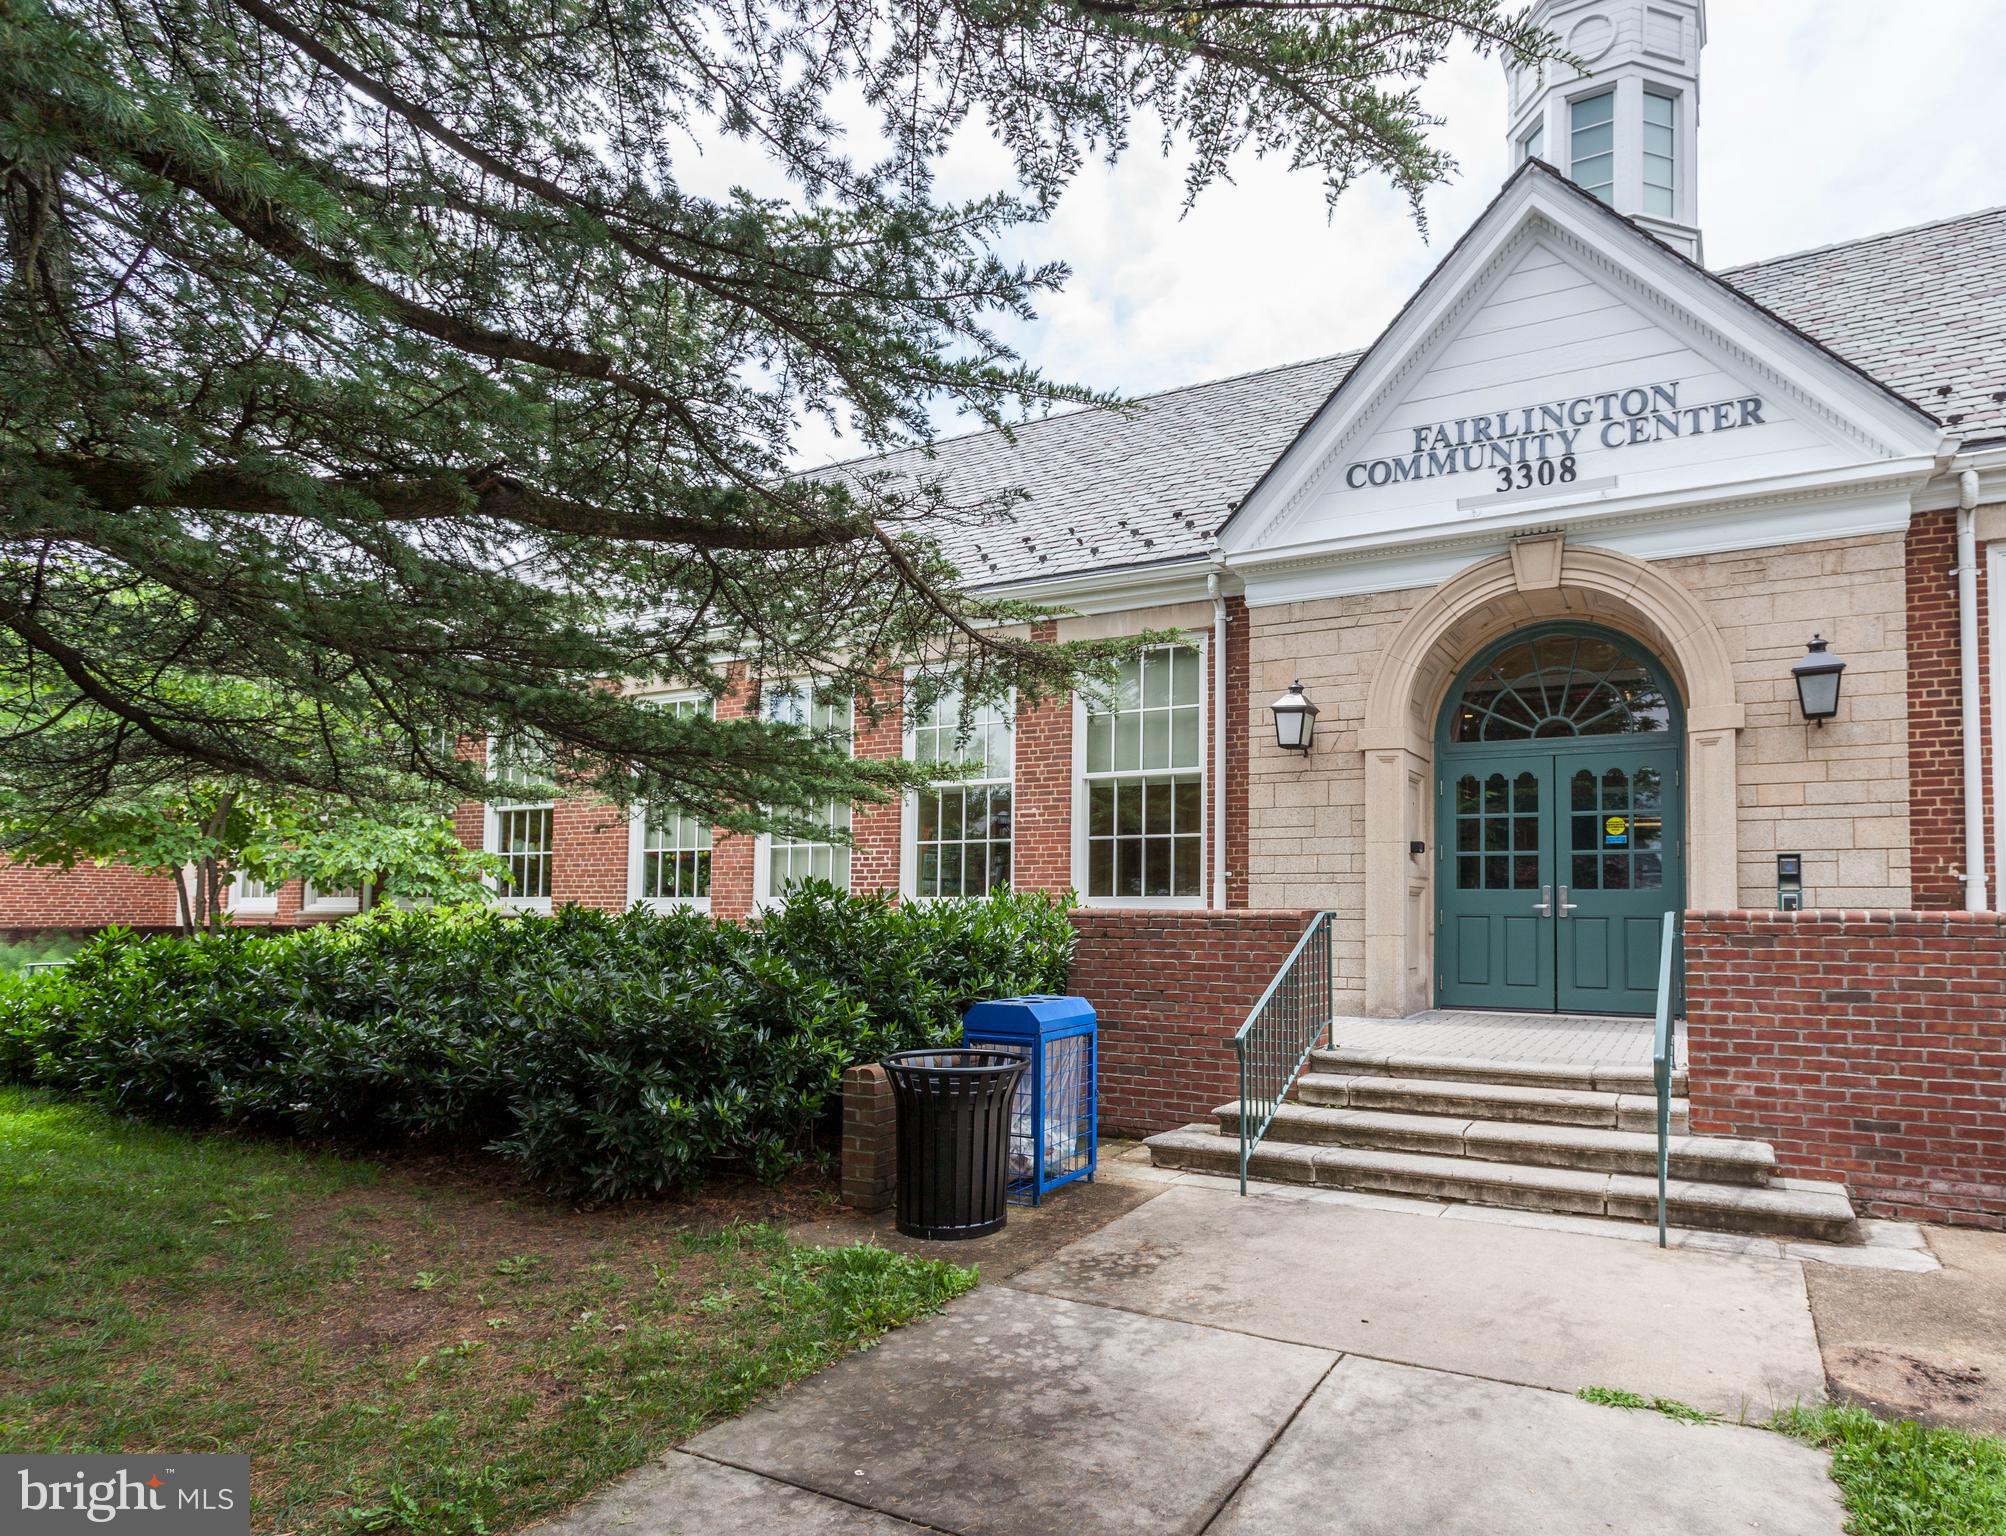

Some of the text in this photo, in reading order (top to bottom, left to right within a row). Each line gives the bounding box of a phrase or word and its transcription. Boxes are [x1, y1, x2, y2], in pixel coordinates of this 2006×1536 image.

[1346, 397, 1766, 489] COMMUNITY CENTER
[1413, 382, 1680, 453] FAIRLINGTON
[1496, 456, 1577, 492] 3308
